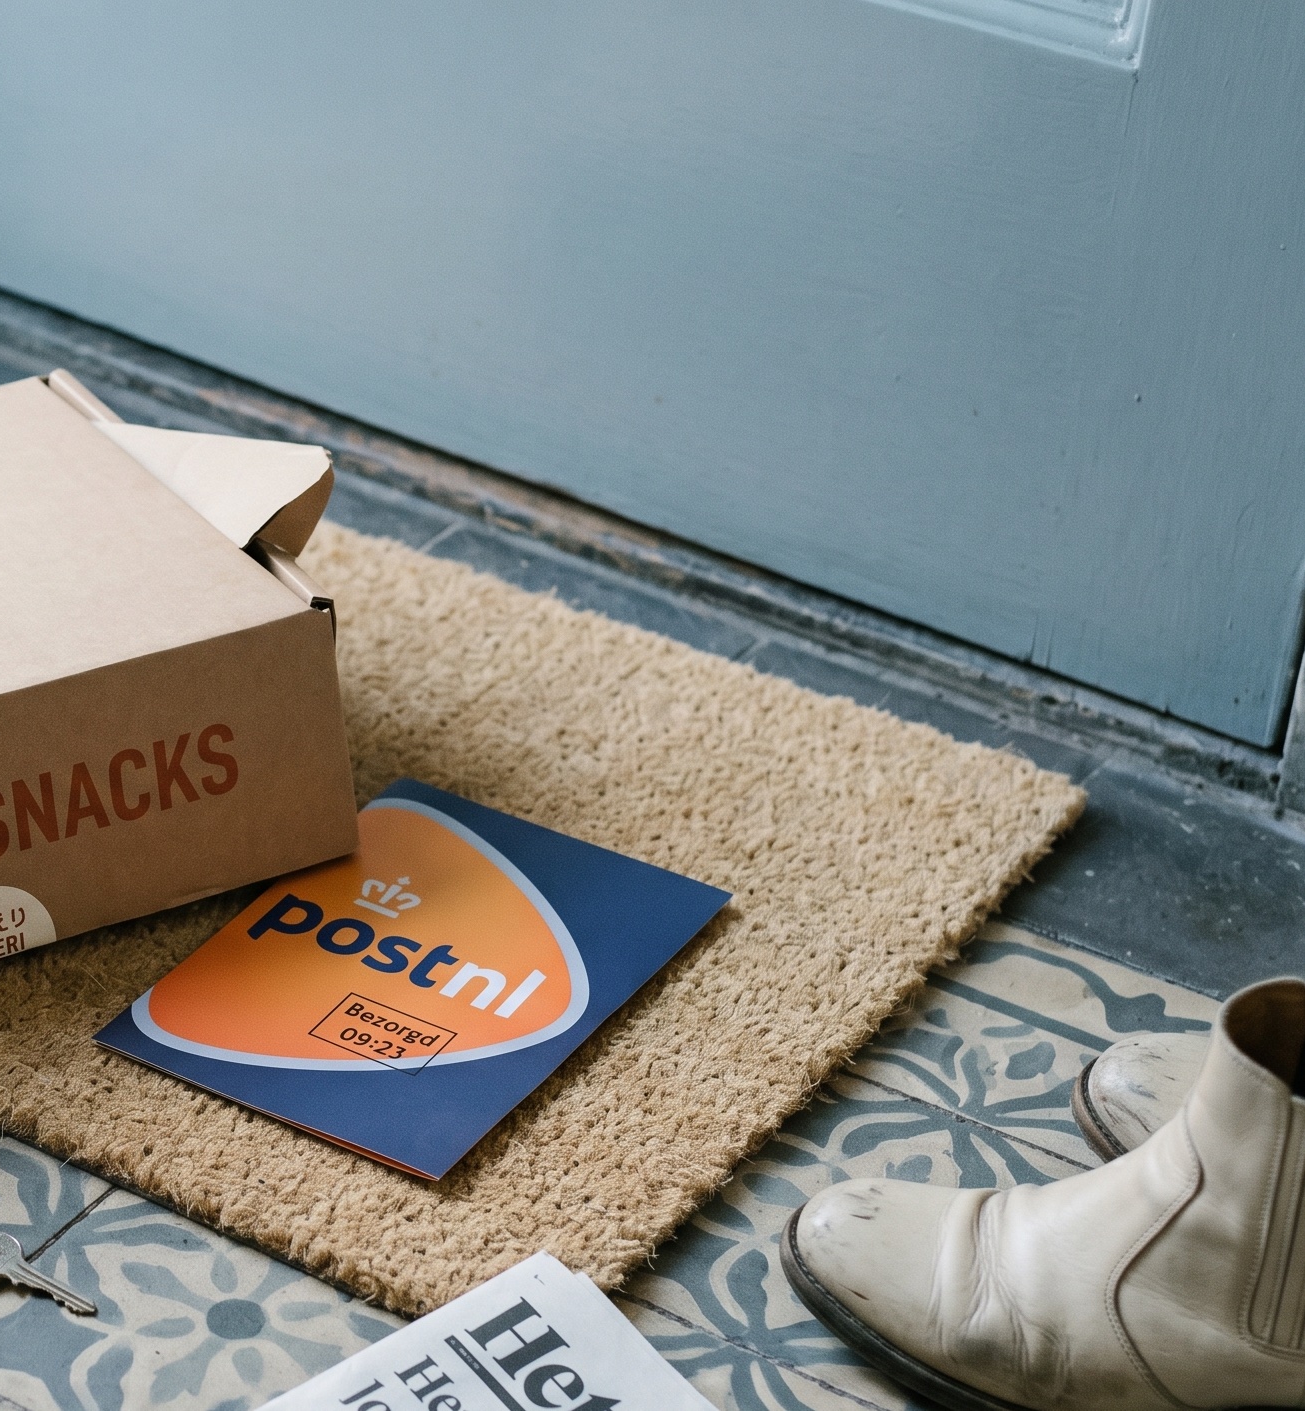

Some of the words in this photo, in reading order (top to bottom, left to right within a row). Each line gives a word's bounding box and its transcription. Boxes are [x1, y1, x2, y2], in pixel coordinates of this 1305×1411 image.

[247, 893, 547, 1019] postnl
[339, 1027, 407, 1060] 09:23
[344, 1002, 441, 1047] Bezorgd
